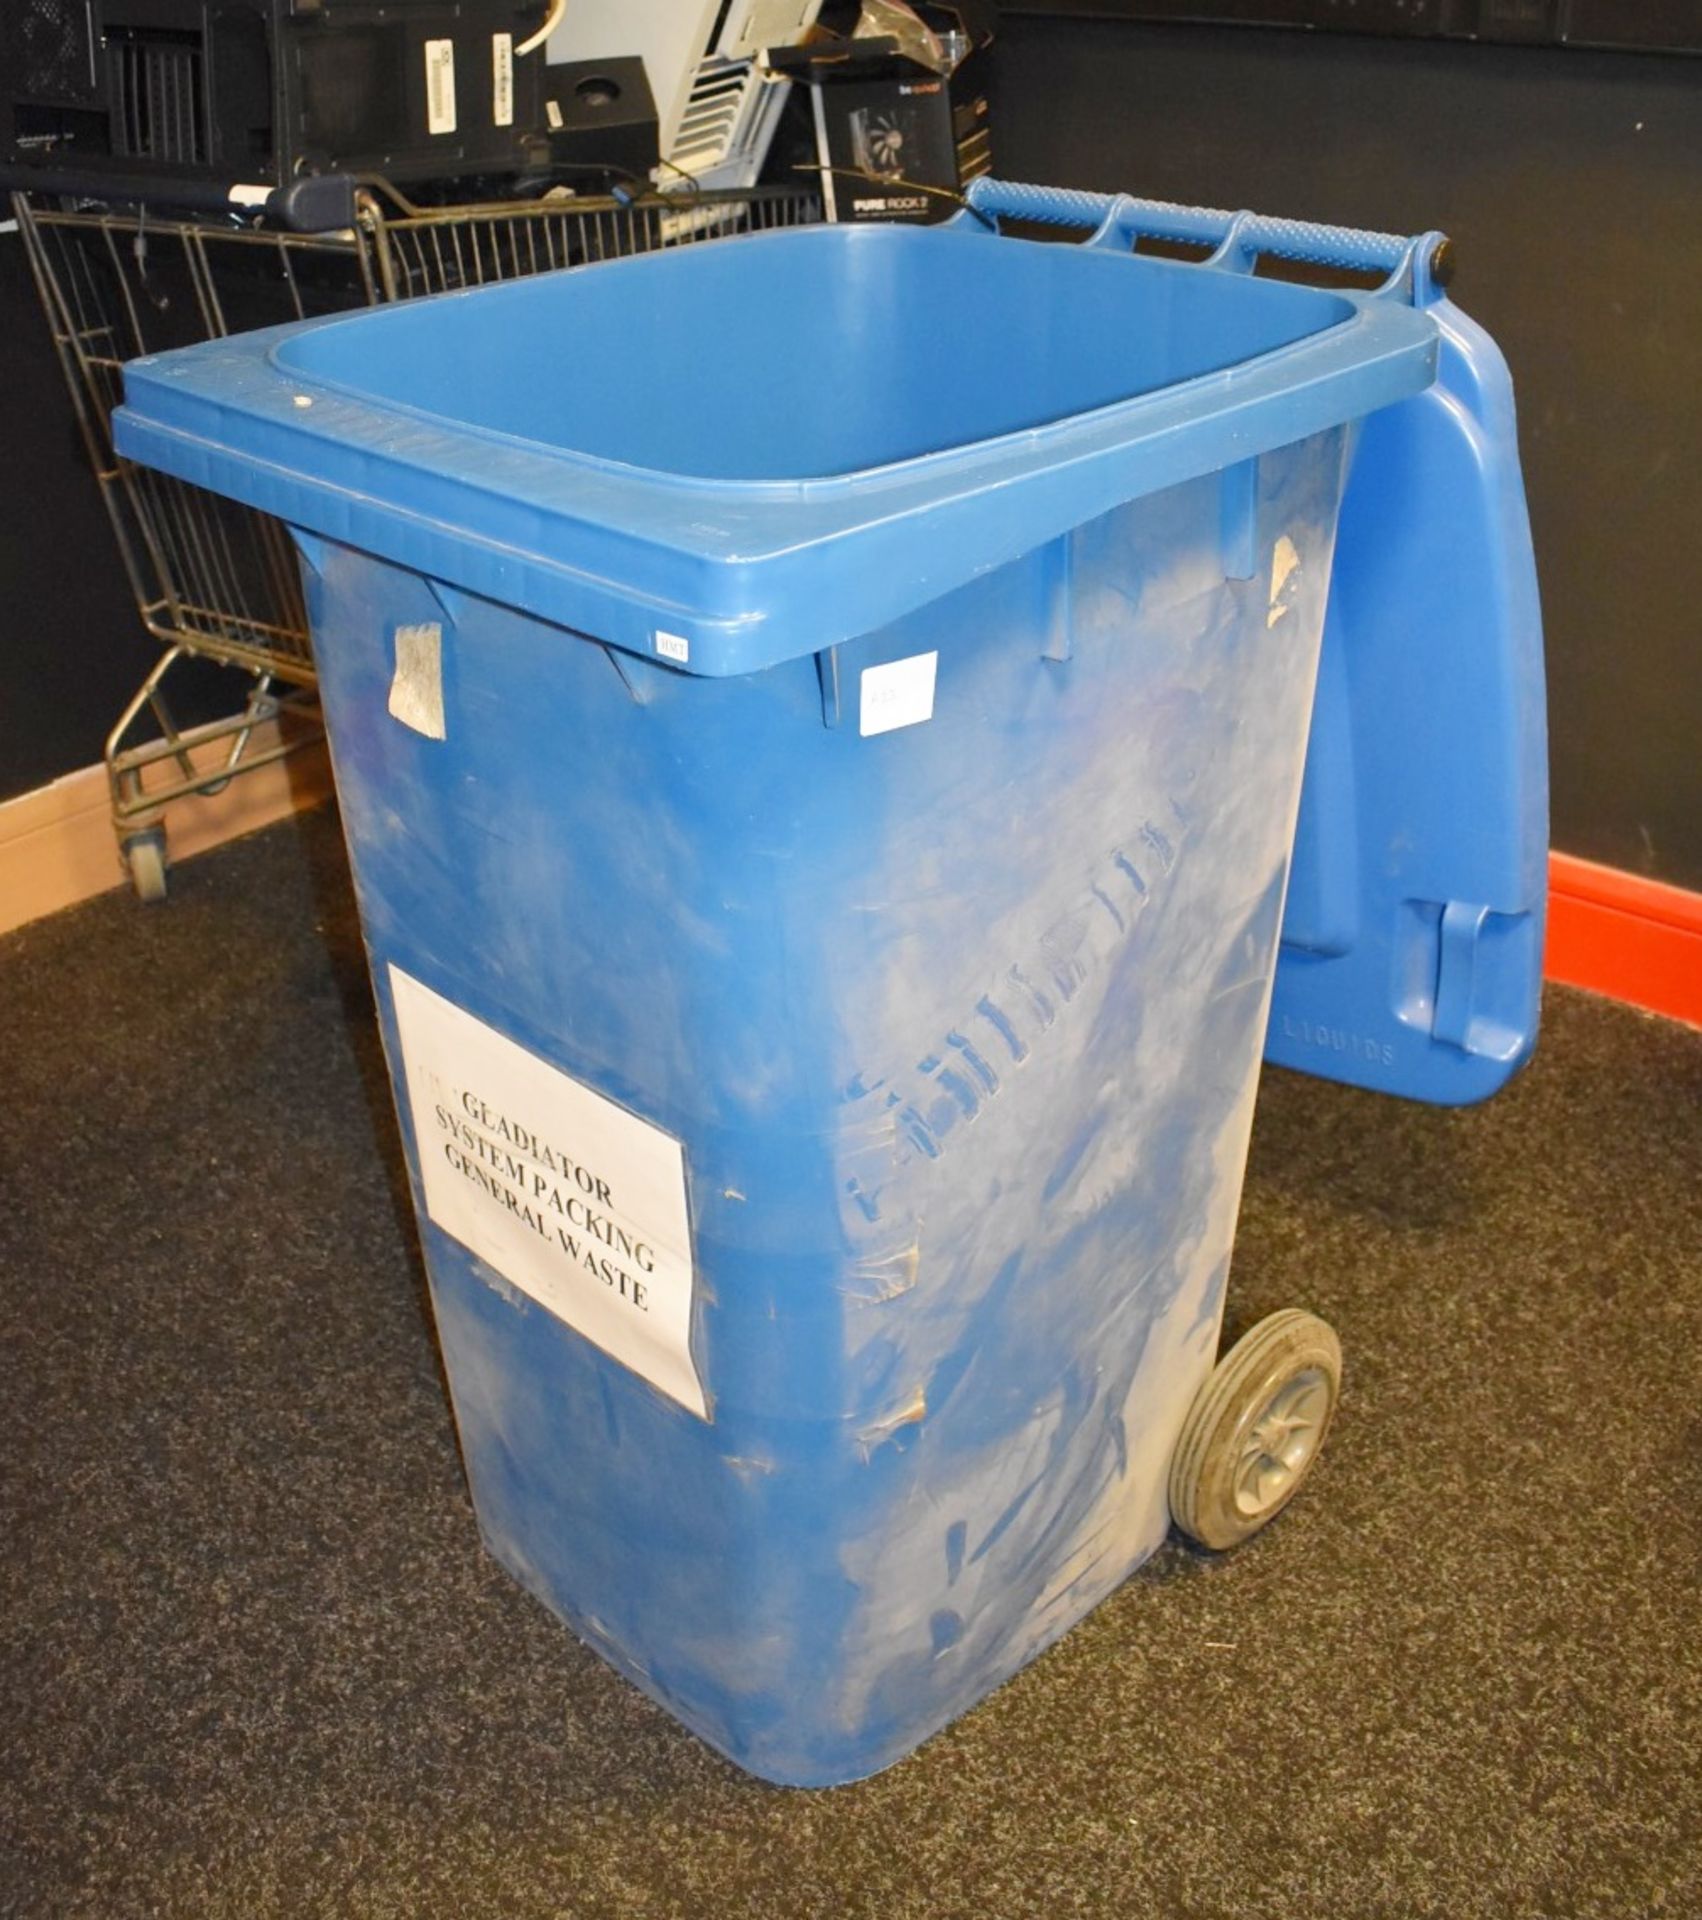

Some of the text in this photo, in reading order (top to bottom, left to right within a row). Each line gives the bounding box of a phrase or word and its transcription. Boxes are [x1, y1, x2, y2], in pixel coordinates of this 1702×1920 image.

[854, 199, 886, 211] PURE
[435, 1105, 656, 1274] SYSTEM PACKING
[461, 1090, 614, 1209] GLADIATOR
[443, 1143, 650, 1313] GENERAL WASTE
